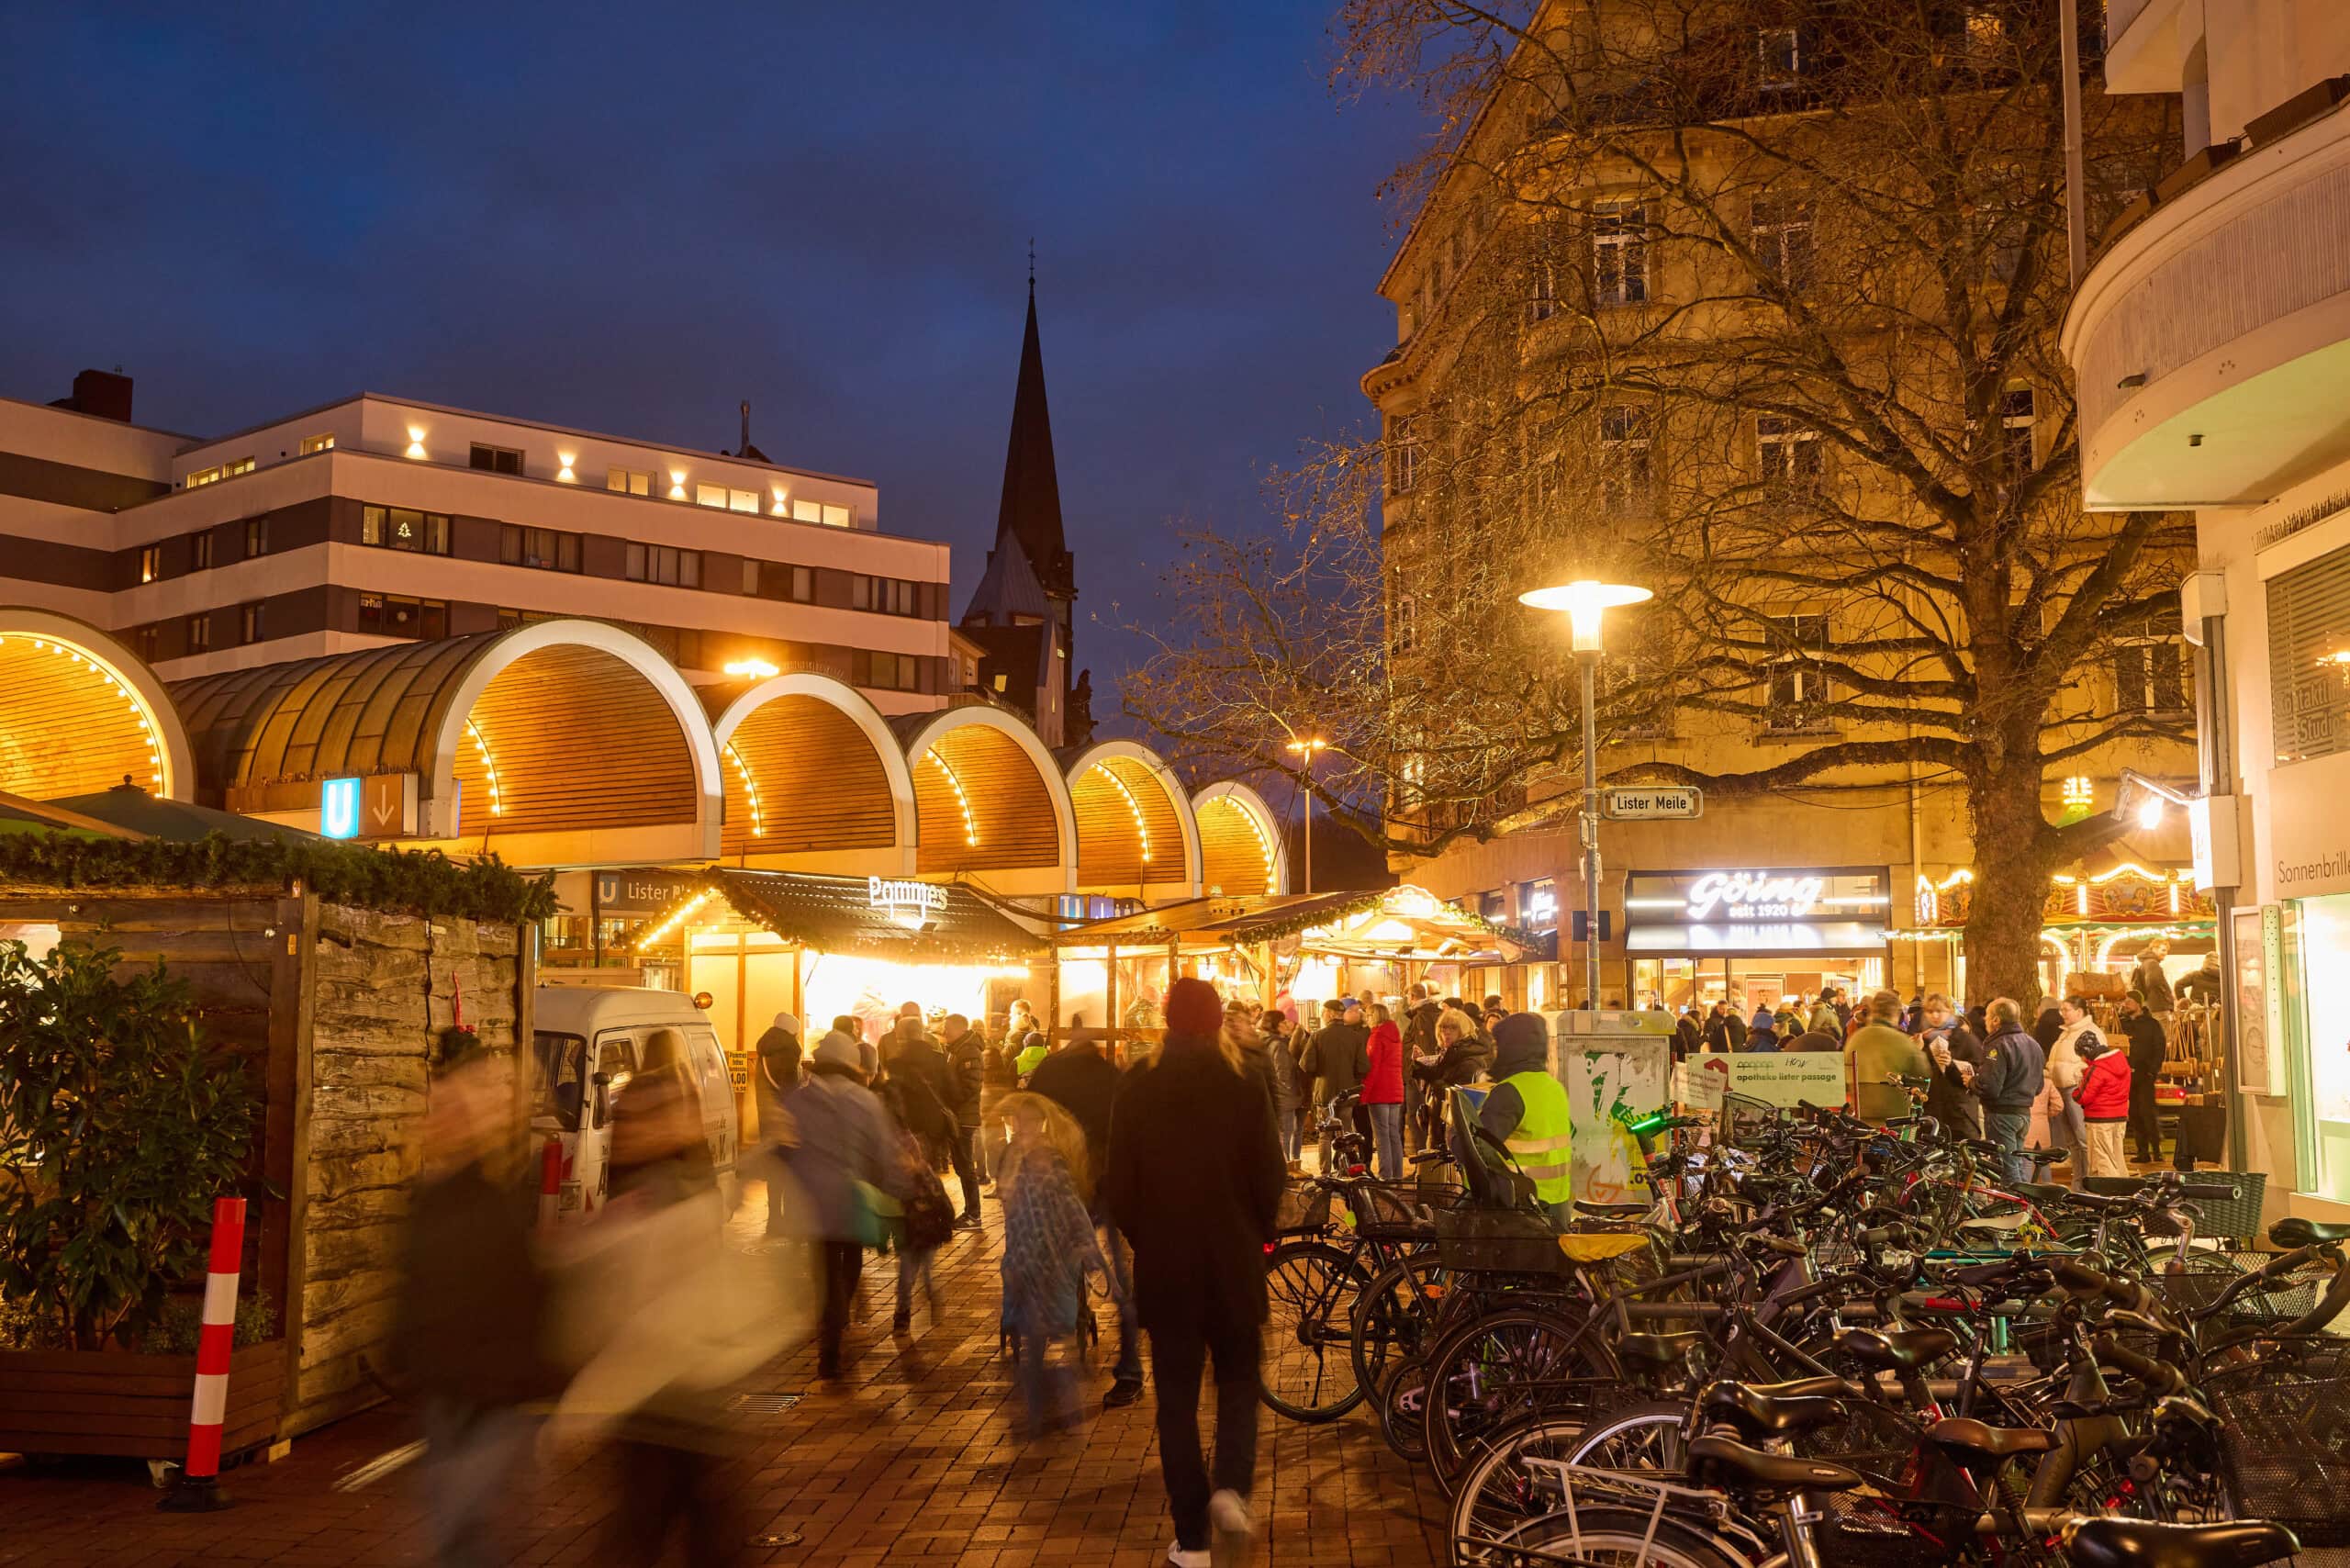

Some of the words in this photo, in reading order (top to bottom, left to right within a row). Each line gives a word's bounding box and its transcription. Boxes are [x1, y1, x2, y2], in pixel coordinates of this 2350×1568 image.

[328, 782, 353, 834] U
[1617, 796, 1650, 810] Lister
[1656, 796, 1686, 809] Meile
[628, 882, 668, 901] Lister
[868, 876, 948, 911] Pommes
[1687, 872, 1823, 920] Göing
[1758, 904, 1788, 917] 1920
[1801, 1074, 1837, 1082] passage
